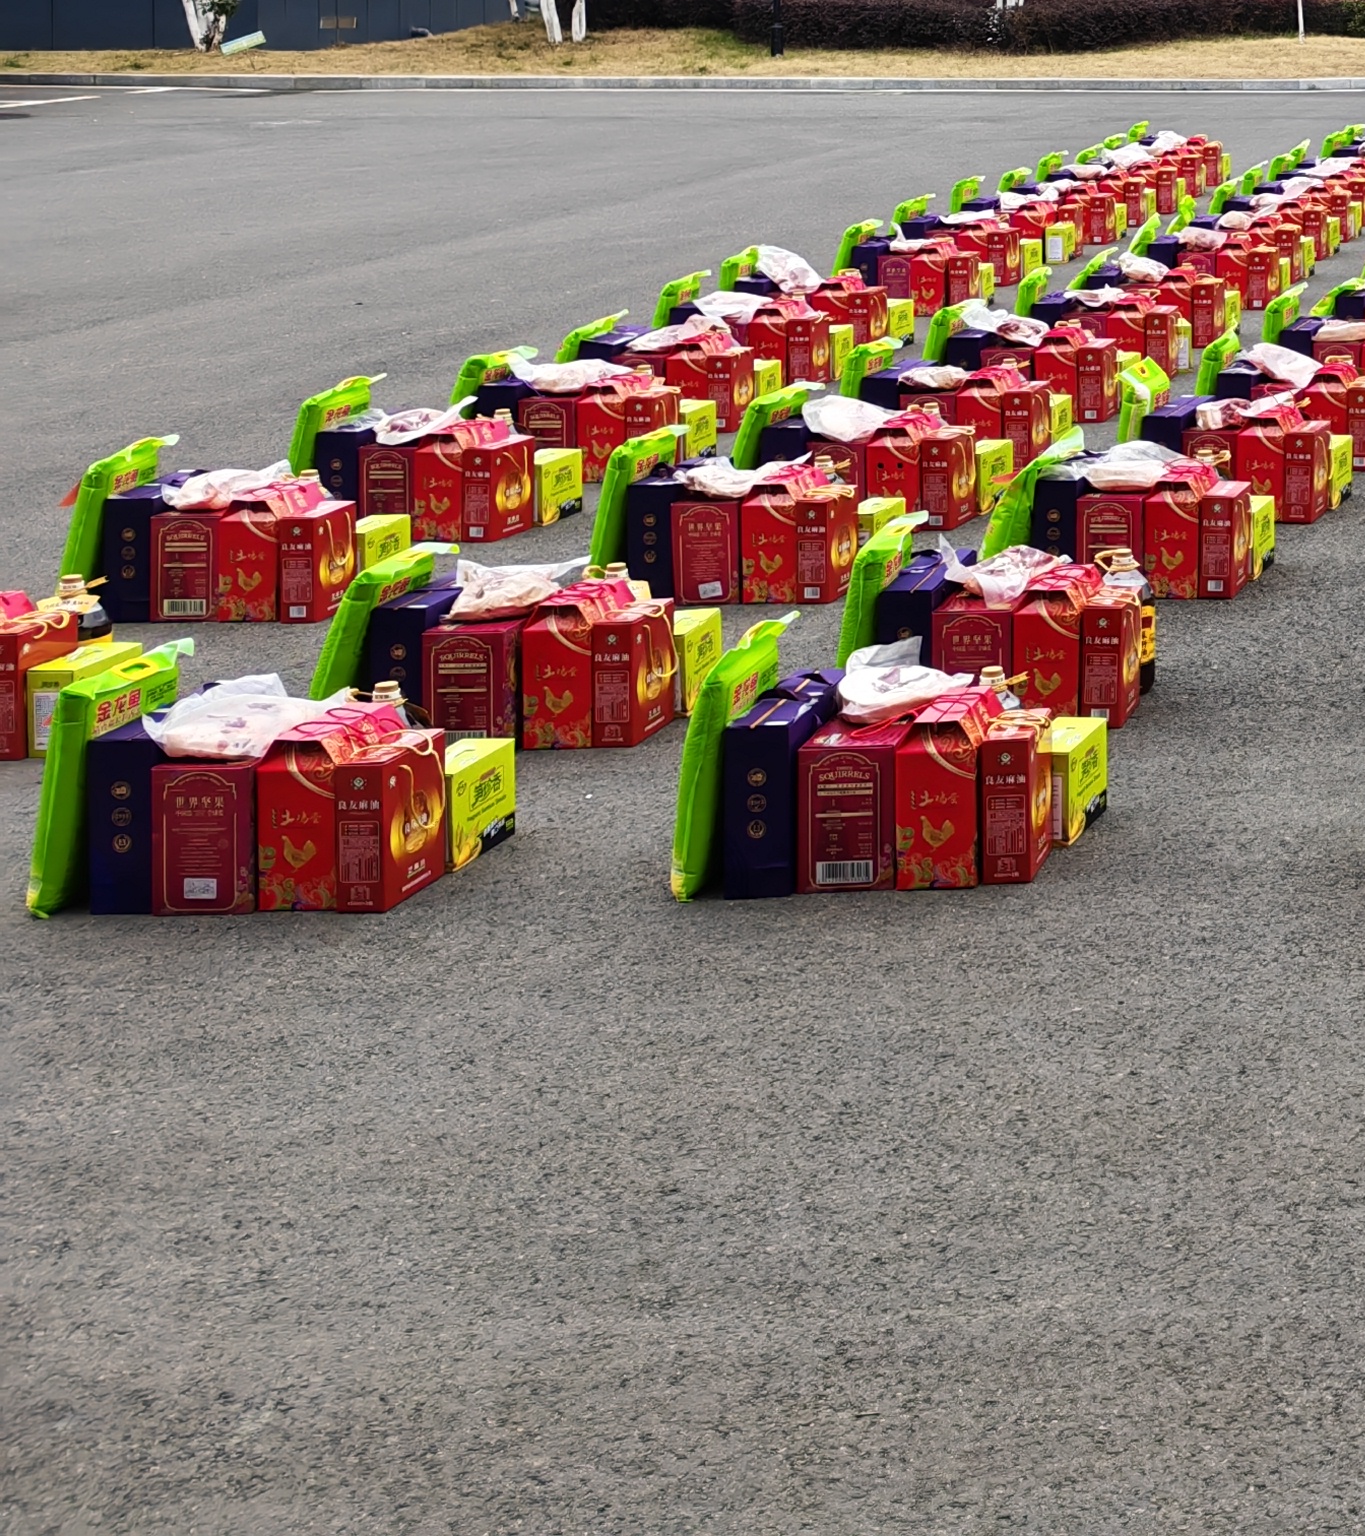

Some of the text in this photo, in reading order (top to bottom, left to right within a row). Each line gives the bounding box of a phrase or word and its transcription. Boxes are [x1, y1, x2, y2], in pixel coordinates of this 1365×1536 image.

[1202, 518, 1231, 527] 良友麻油
[797, 525, 826, 534] 良友麻油
[281, 543, 312, 551] 良友麻油
[378, 575, 412, 606] 金龙鱼
[952, 635, 992, 645] 世界坚果
[1085, 636, 1120, 646] 良友麻油
[439, 651, 484, 662] SQUIRRELS
[594, 652, 630, 662] 良友麻油
[733, 671, 759, 707] 金龙鱼
[96, 686, 142, 724] 金龙鱼
[818, 769, 871, 781] SQUIRRELS
[985, 774, 1026, 786] 良友麻油
[176, 796, 224, 809] 世界坚果
[338, 799, 380, 811] 良友麻油
